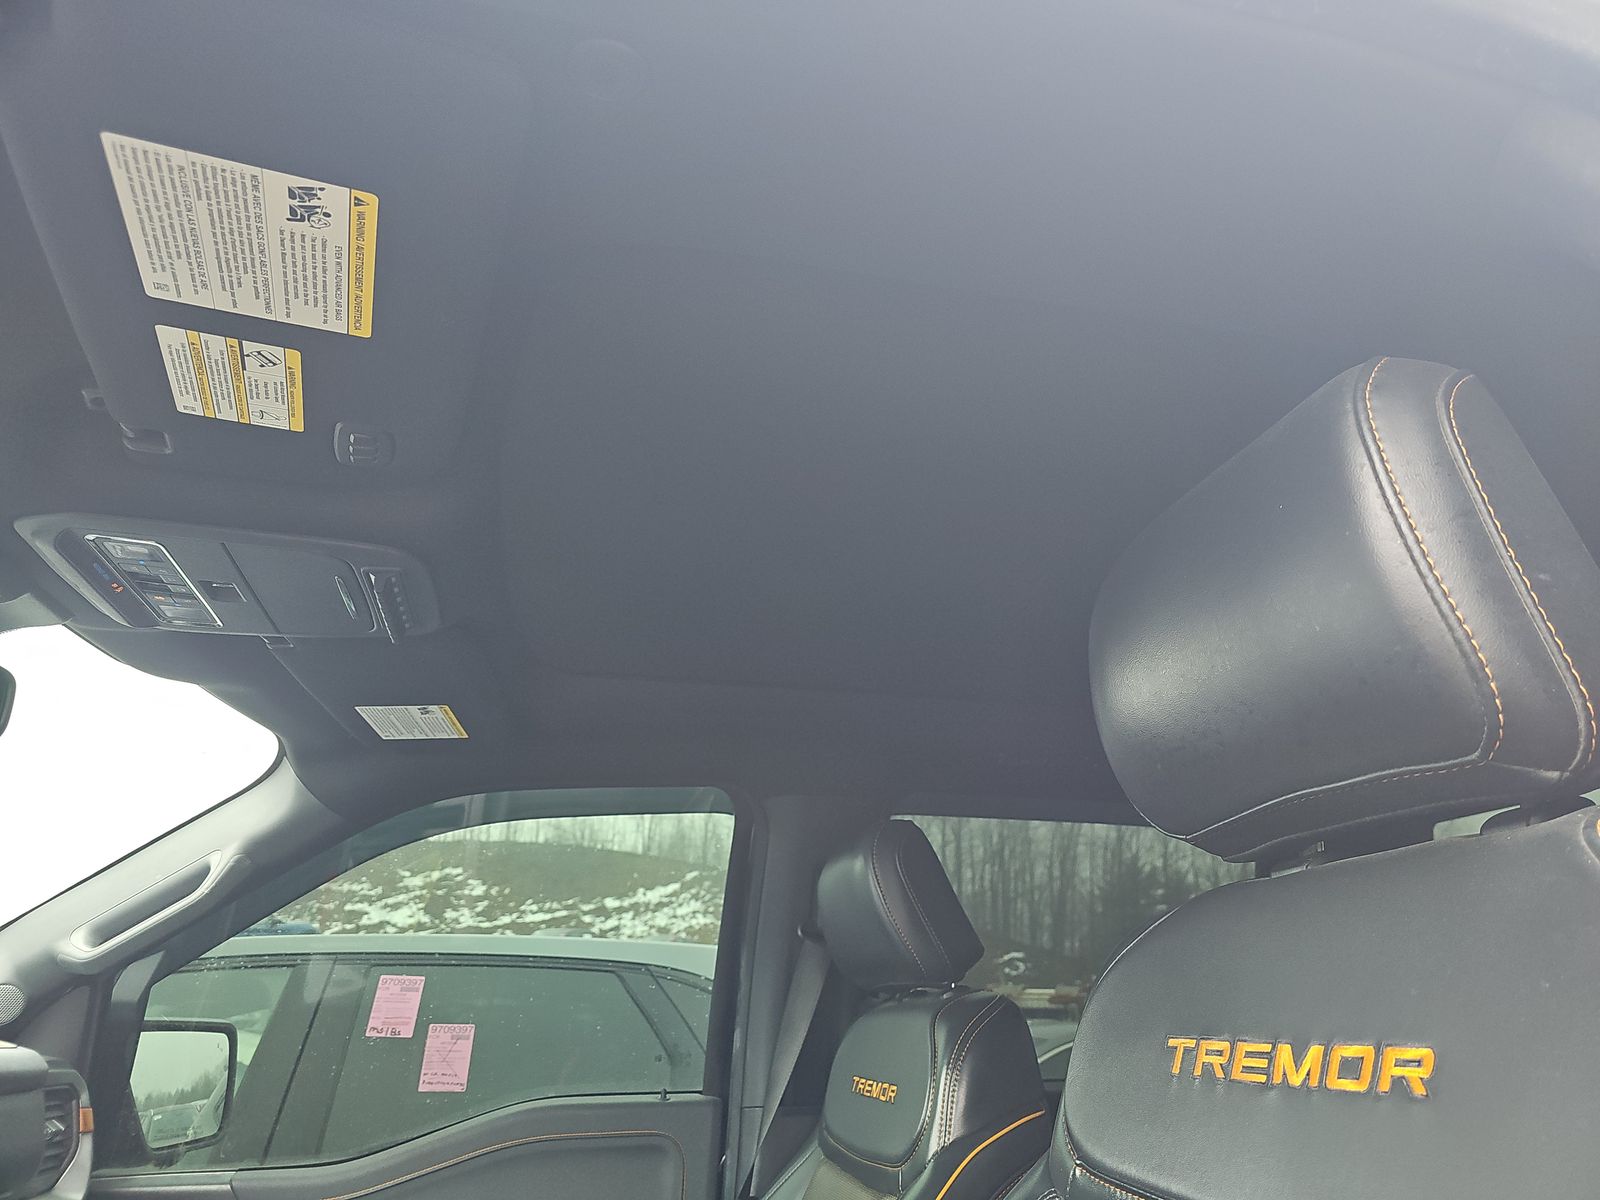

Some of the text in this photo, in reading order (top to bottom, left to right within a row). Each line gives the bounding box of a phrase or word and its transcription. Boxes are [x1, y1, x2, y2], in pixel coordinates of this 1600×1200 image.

[176, 164, 191, 199] INCLUSIVE
[183, 199, 194, 213] CON
[252, 194, 262, 210] AVEC
[186, 213, 196, 226] LAS
[253, 211, 263, 224] DES
[255, 225, 265, 241] SACS
[356, 210, 365, 242] WARNING
[188, 226, 201, 249] NUEVAS
[193, 249, 205, 270] BOLSAS
[257, 241, 268, 276] GONFLABLES
[197, 270, 206, 279] DE
[199, 278, 208, 290] AIRE
[381, 978, 424, 986] 9709397
[431, 1025, 474, 1033] 9709397
[1166, 1036, 1435, 1097] TREMOR
[851, 1075, 897, 1104] TREMOR
